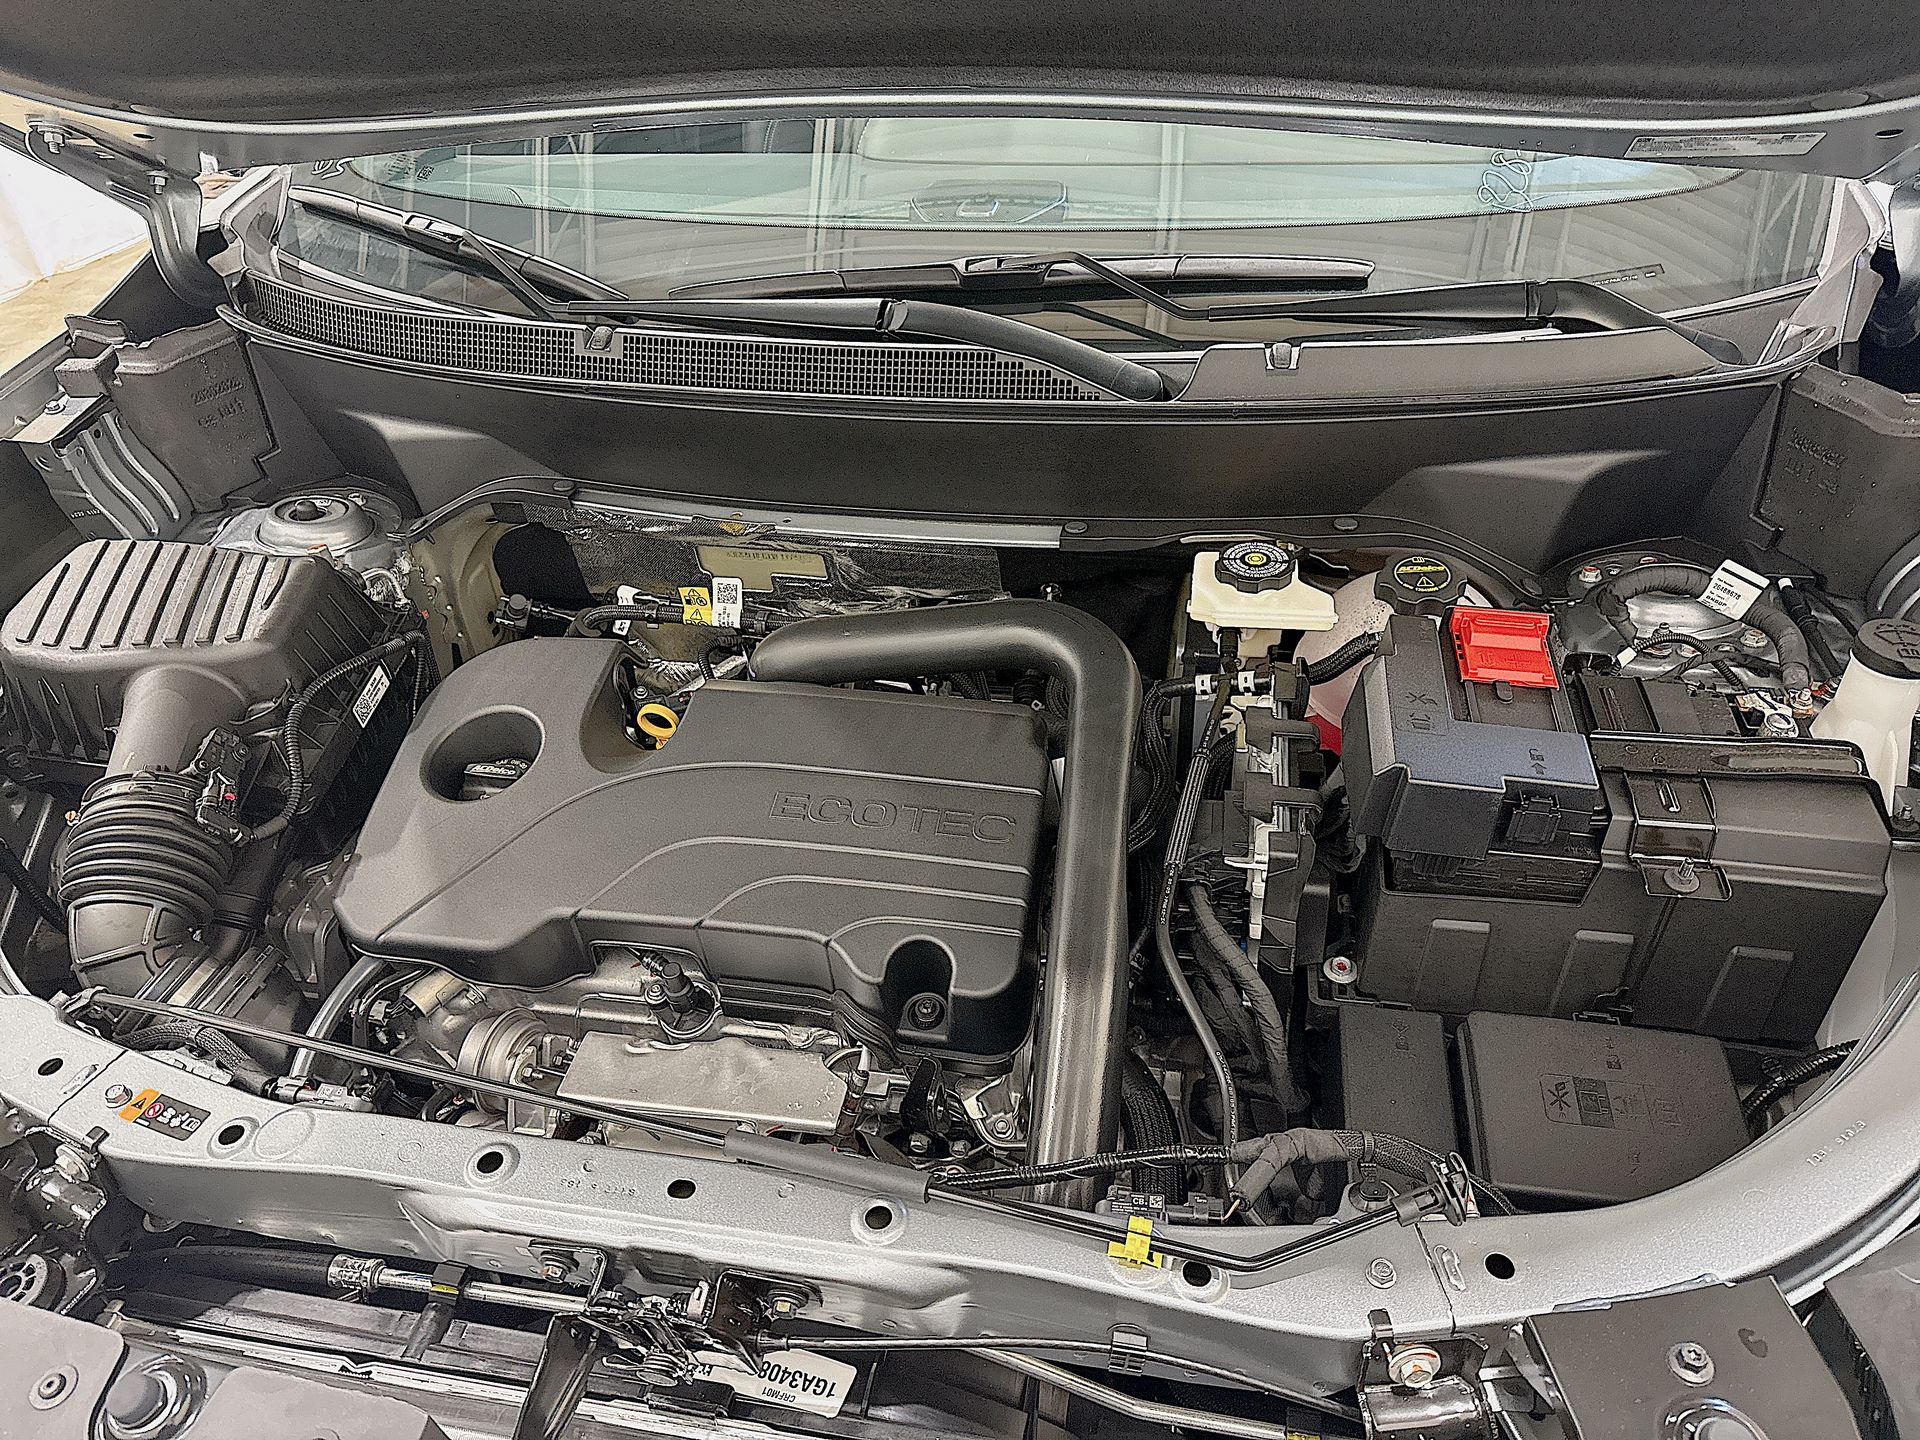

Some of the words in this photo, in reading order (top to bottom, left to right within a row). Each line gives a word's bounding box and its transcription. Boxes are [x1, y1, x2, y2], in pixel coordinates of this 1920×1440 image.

[769, 791, 1017, 844] ECOTEC
[757, 1360, 837, 1399] 1GA3408
[761, 1386, 796, 1404] CRFM01
